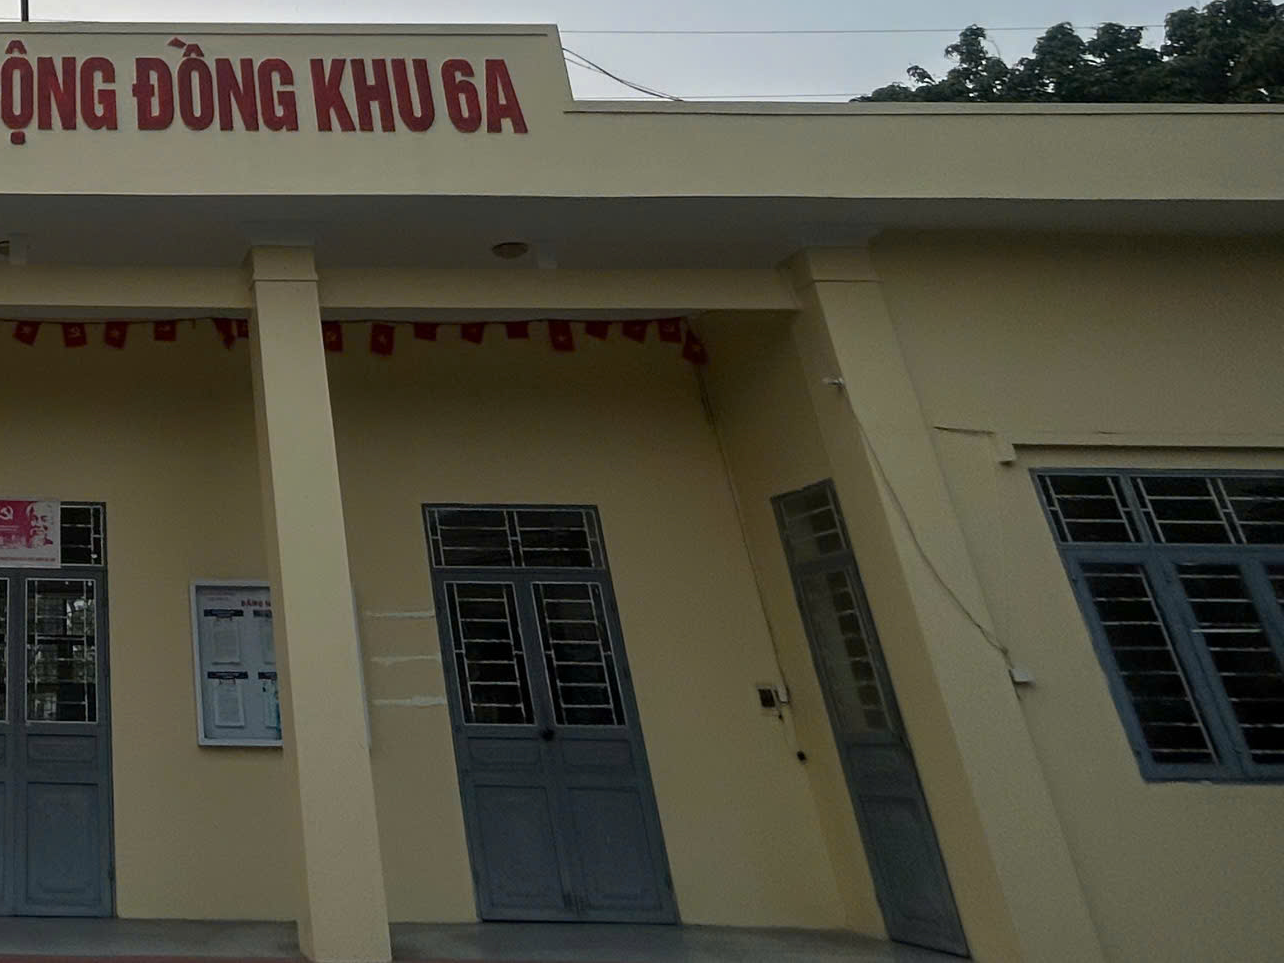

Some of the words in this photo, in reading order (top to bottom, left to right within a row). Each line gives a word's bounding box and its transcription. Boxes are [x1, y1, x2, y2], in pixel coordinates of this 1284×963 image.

[132, 37, 299, 132] ĐỒNG
[310, 57, 435, 133] KHU
[441, 58, 528, 134] 6A
